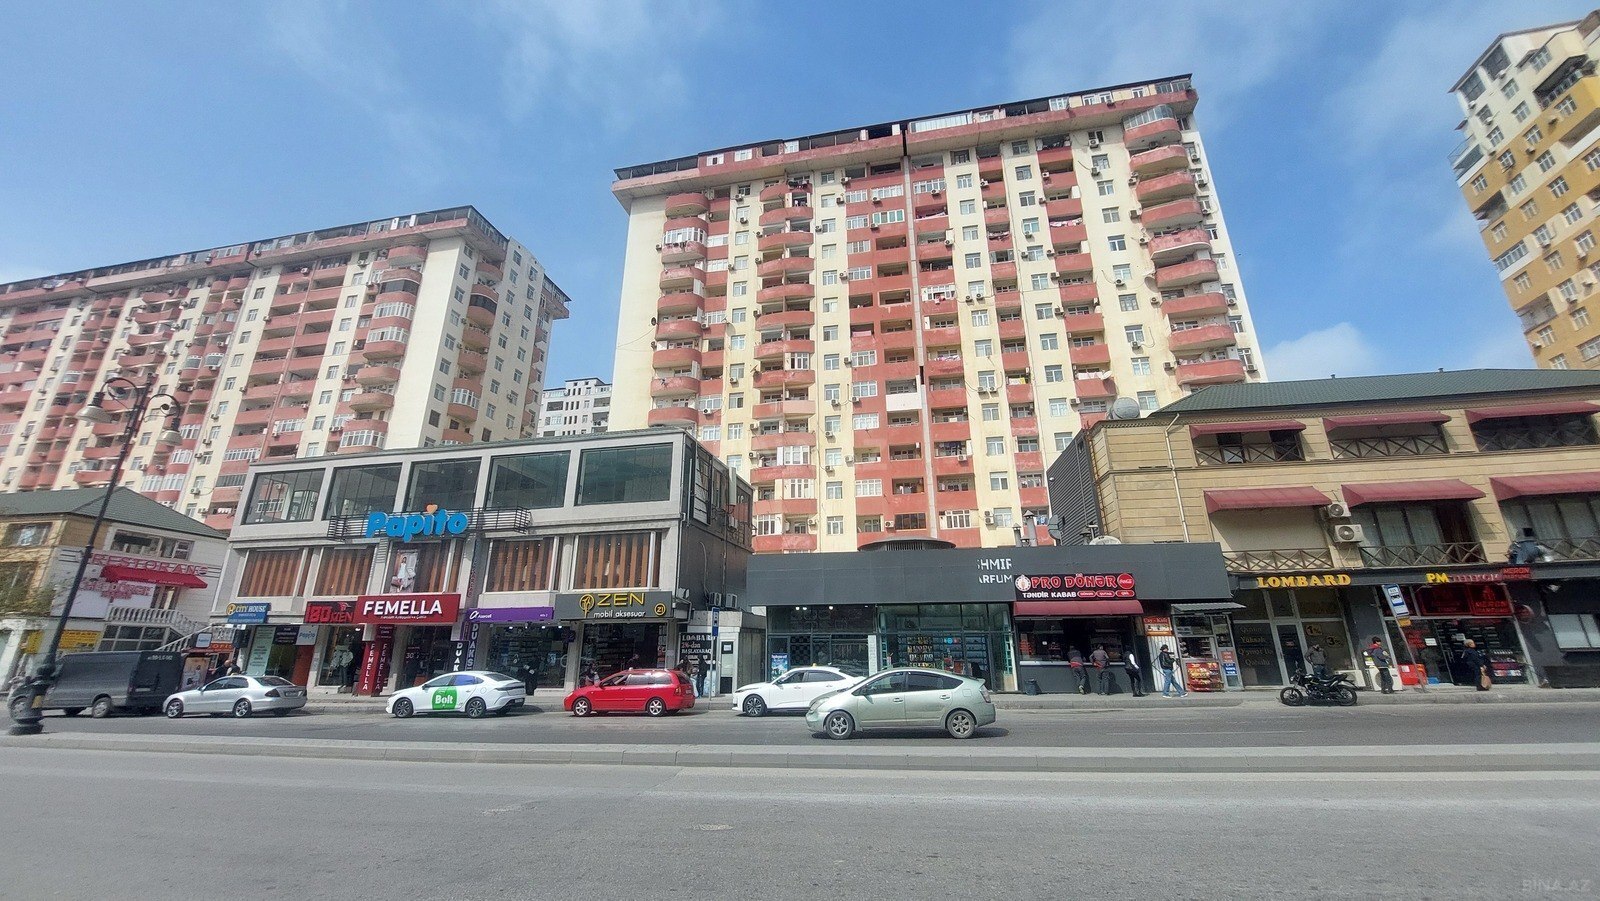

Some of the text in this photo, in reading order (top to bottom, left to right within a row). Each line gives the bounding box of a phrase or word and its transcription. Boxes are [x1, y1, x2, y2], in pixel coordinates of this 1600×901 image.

[365, 504, 469, 543] Papito
[1030, 573, 1117, 589] PRO DÖNƏR
[1256, 574, 1352, 588] LOMBARD
[1426, 573, 1450, 583] PM
[597, 593, 645, 606] ZEN
[1022, 590, 1049, 598] TƏNDİR
[248, 605, 266, 613] HOUSE
[363, 599, 442, 616] FEMELLA
[593, 609, 646, 618] mobil aksesuar
[362, 643, 376, 691] FEMELLA
[435, 694, 454, 705] Bolt
